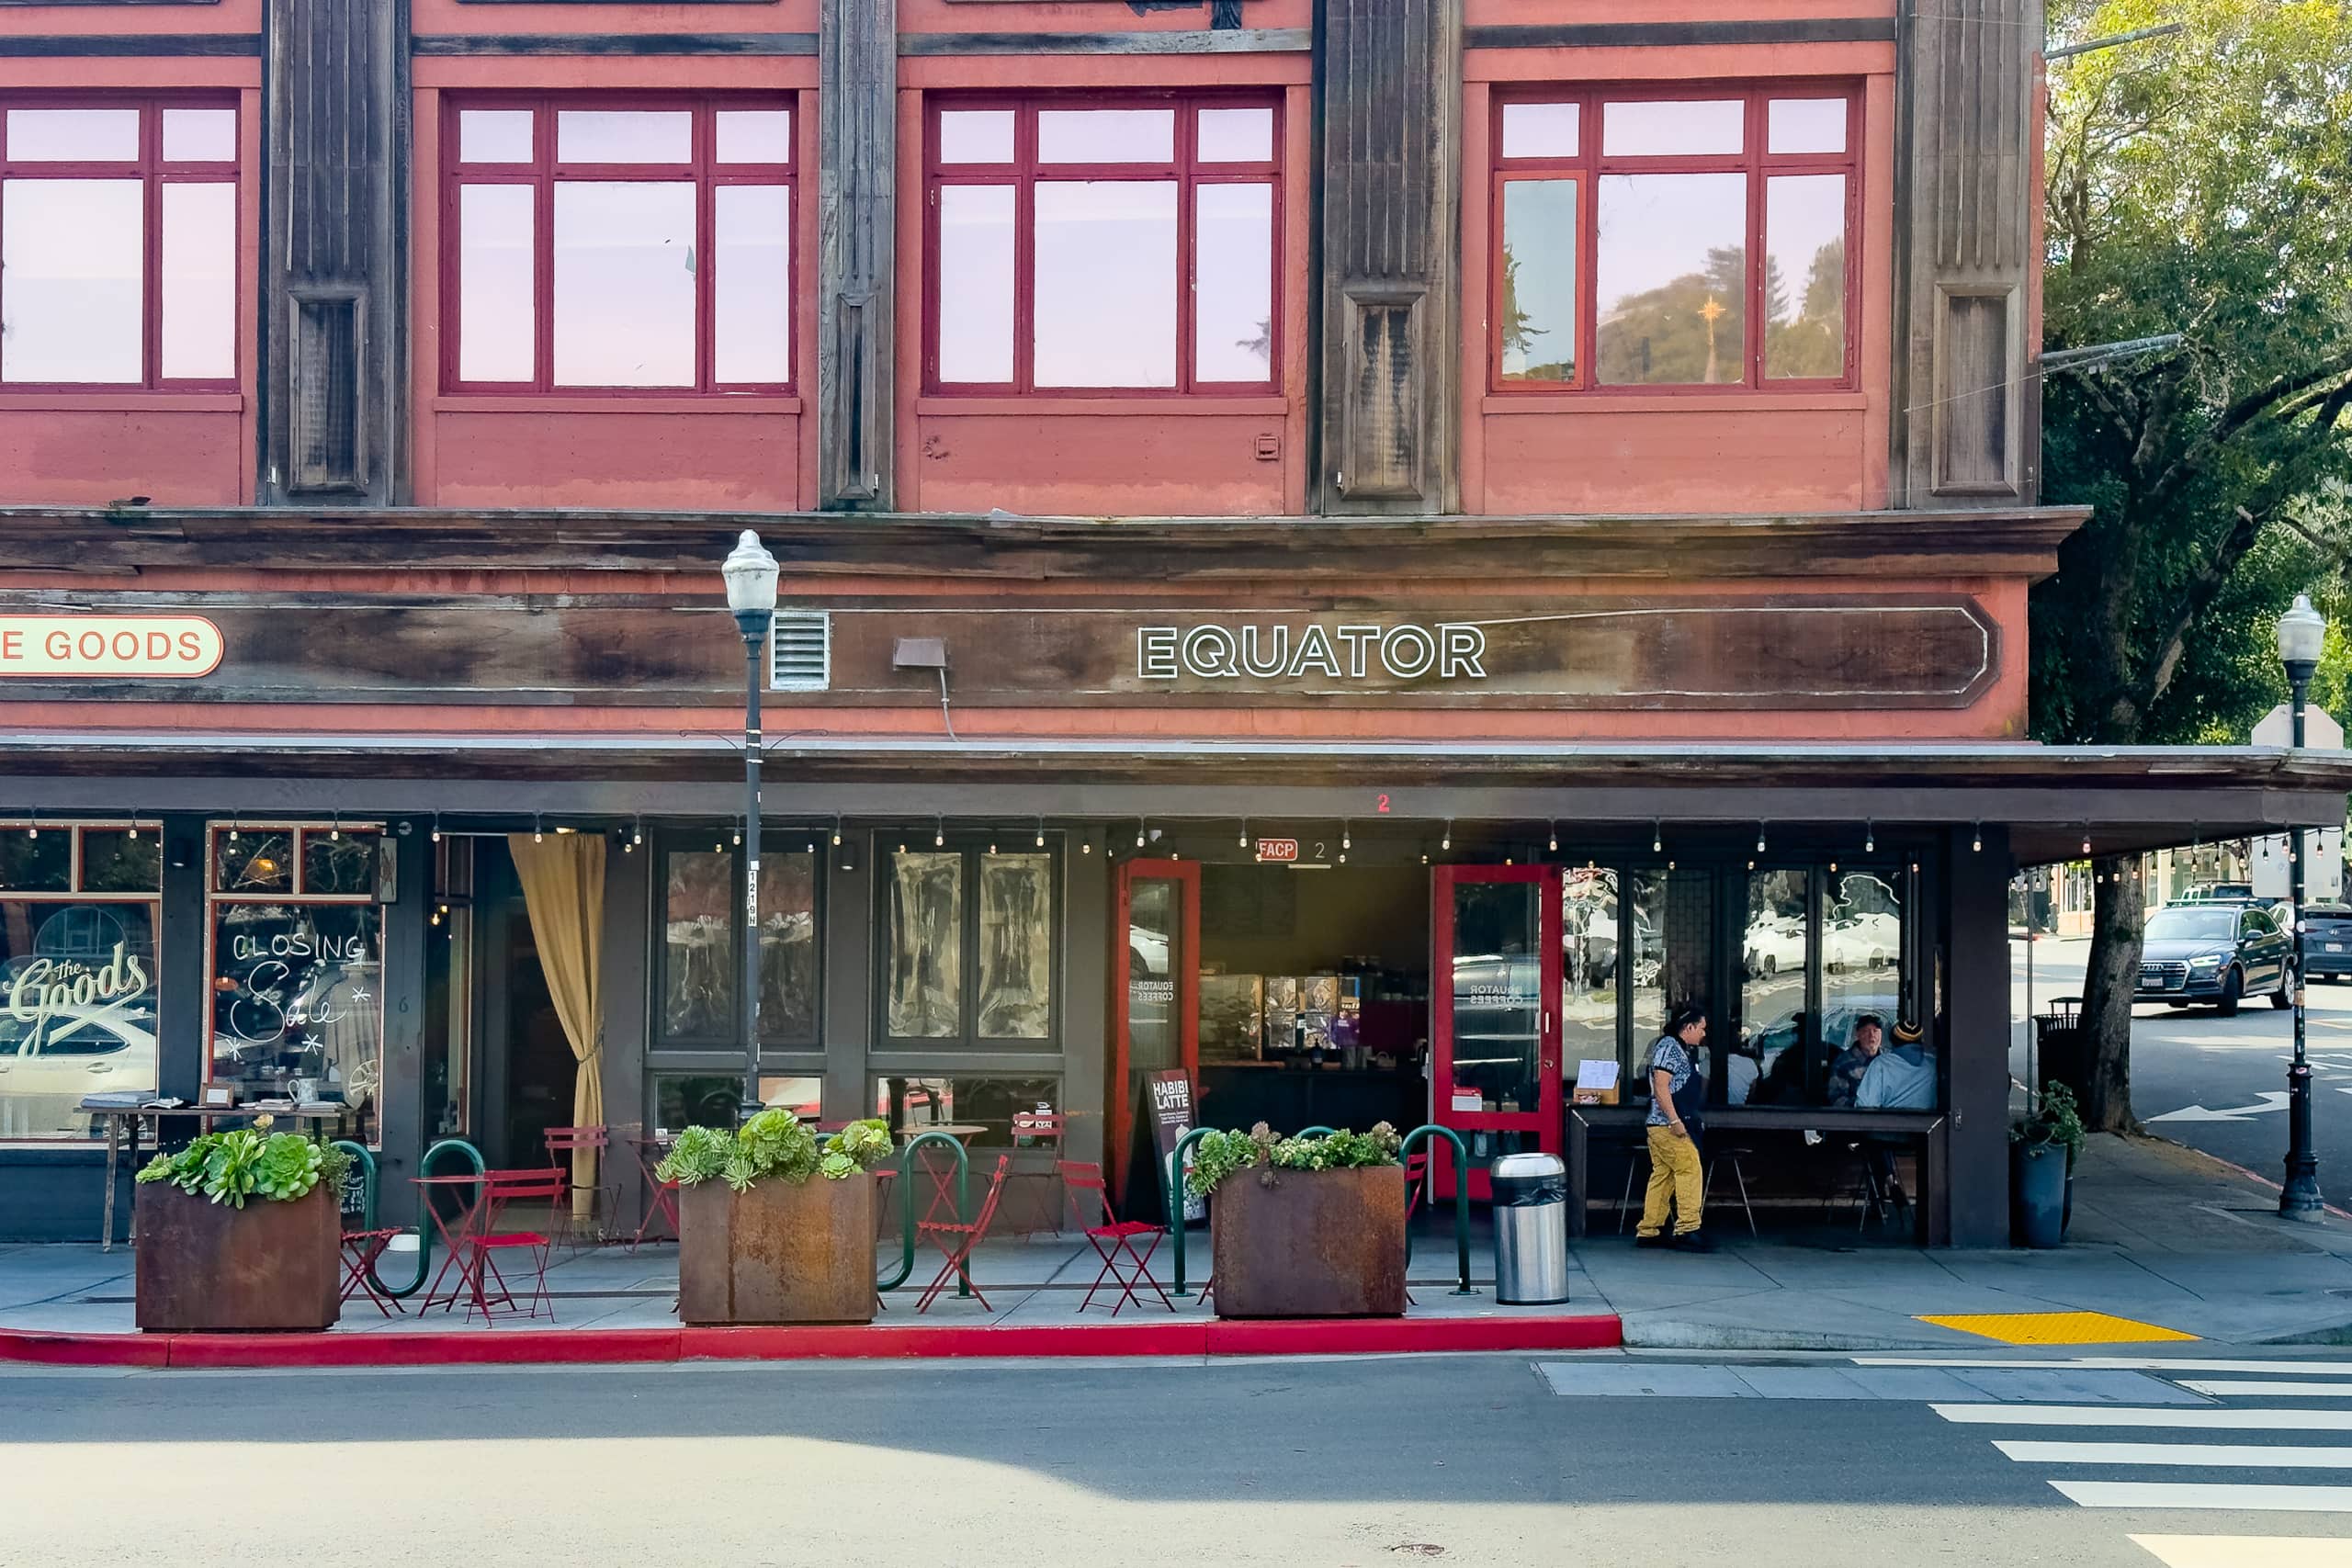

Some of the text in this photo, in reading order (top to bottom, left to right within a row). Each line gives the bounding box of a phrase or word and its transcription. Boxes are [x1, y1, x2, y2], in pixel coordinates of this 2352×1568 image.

[45, 630, 202, 660] GOODS
[1136, 624, 1487, 679] EQUATOR
[1378, 793, 1390, 813] 2
[1259, 842, 1295, 857] FACP
[1315, 842, 1325, 859] 2
[233, 933, 367, 967] CLOSING
[2, 941, 148, 1057] Goods
[230, 960, 347, 1043] Sale
[399, 996, 409, 1013] 6
[1152, 1079, 1189, 1096] HABIBI
[1154, 1094, 1189, 1110] LATTE
